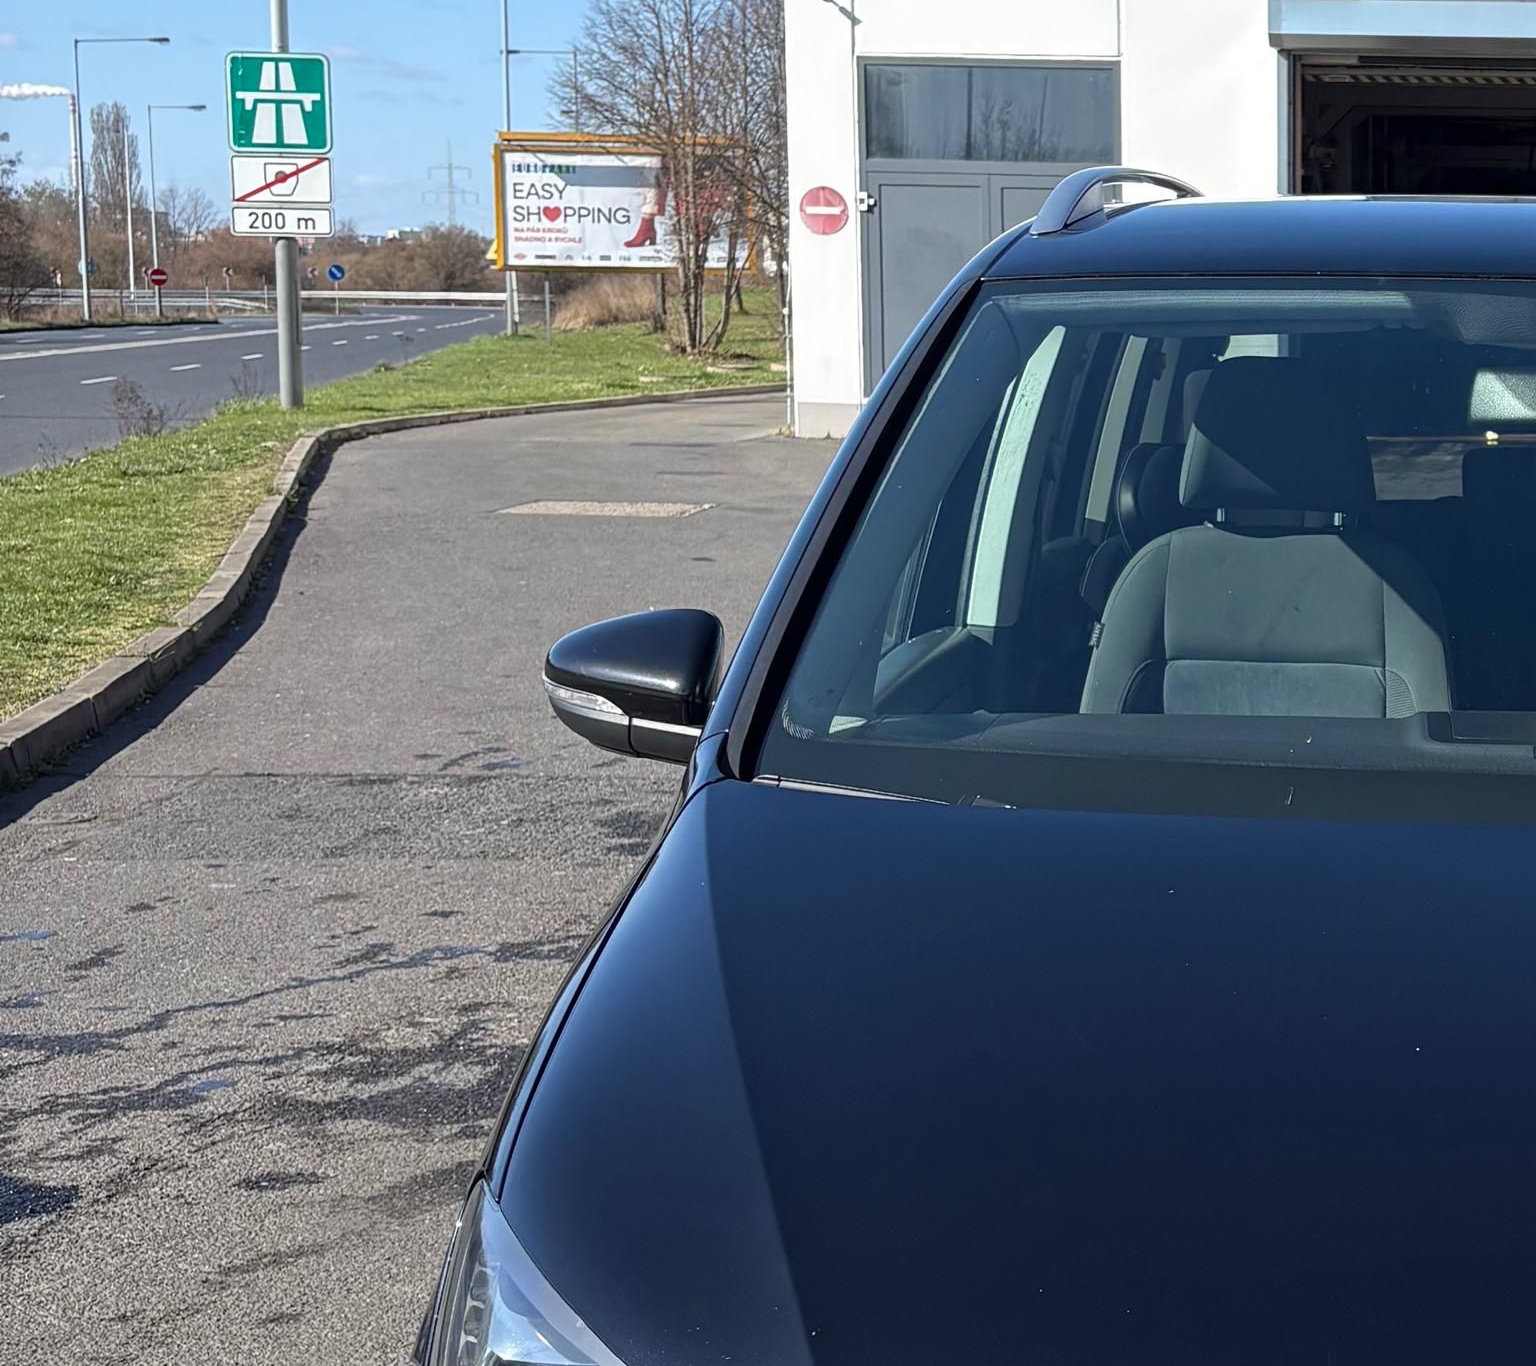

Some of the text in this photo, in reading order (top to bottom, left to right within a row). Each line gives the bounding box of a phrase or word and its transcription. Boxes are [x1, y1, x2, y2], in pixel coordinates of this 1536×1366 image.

[512, 182, 568, 200] EASY
[248, 212, 316, 230] 200 m
